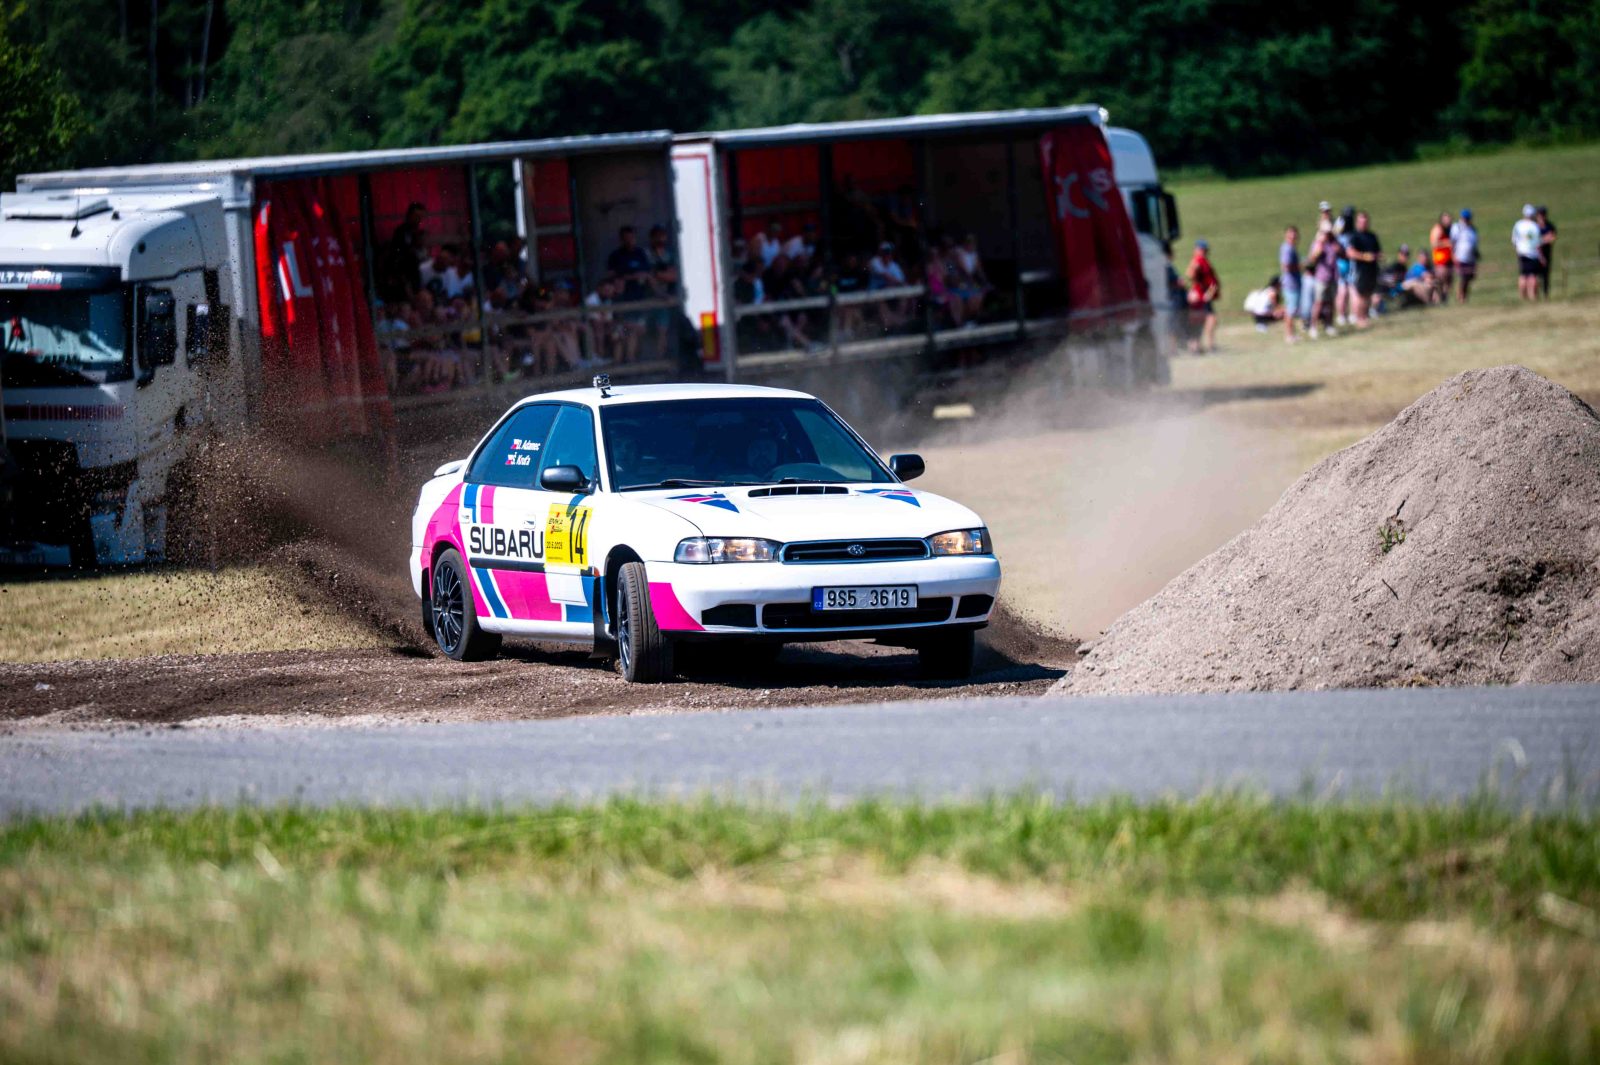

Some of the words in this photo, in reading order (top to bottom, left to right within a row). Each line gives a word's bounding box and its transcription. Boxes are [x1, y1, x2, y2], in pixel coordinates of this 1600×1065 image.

[469, 526, 544, 559] SUBARU
[569, 508, 588, 565] 14
[827, 589, 857, 607] 9S5
[869, 588, 909, 607] 3619
